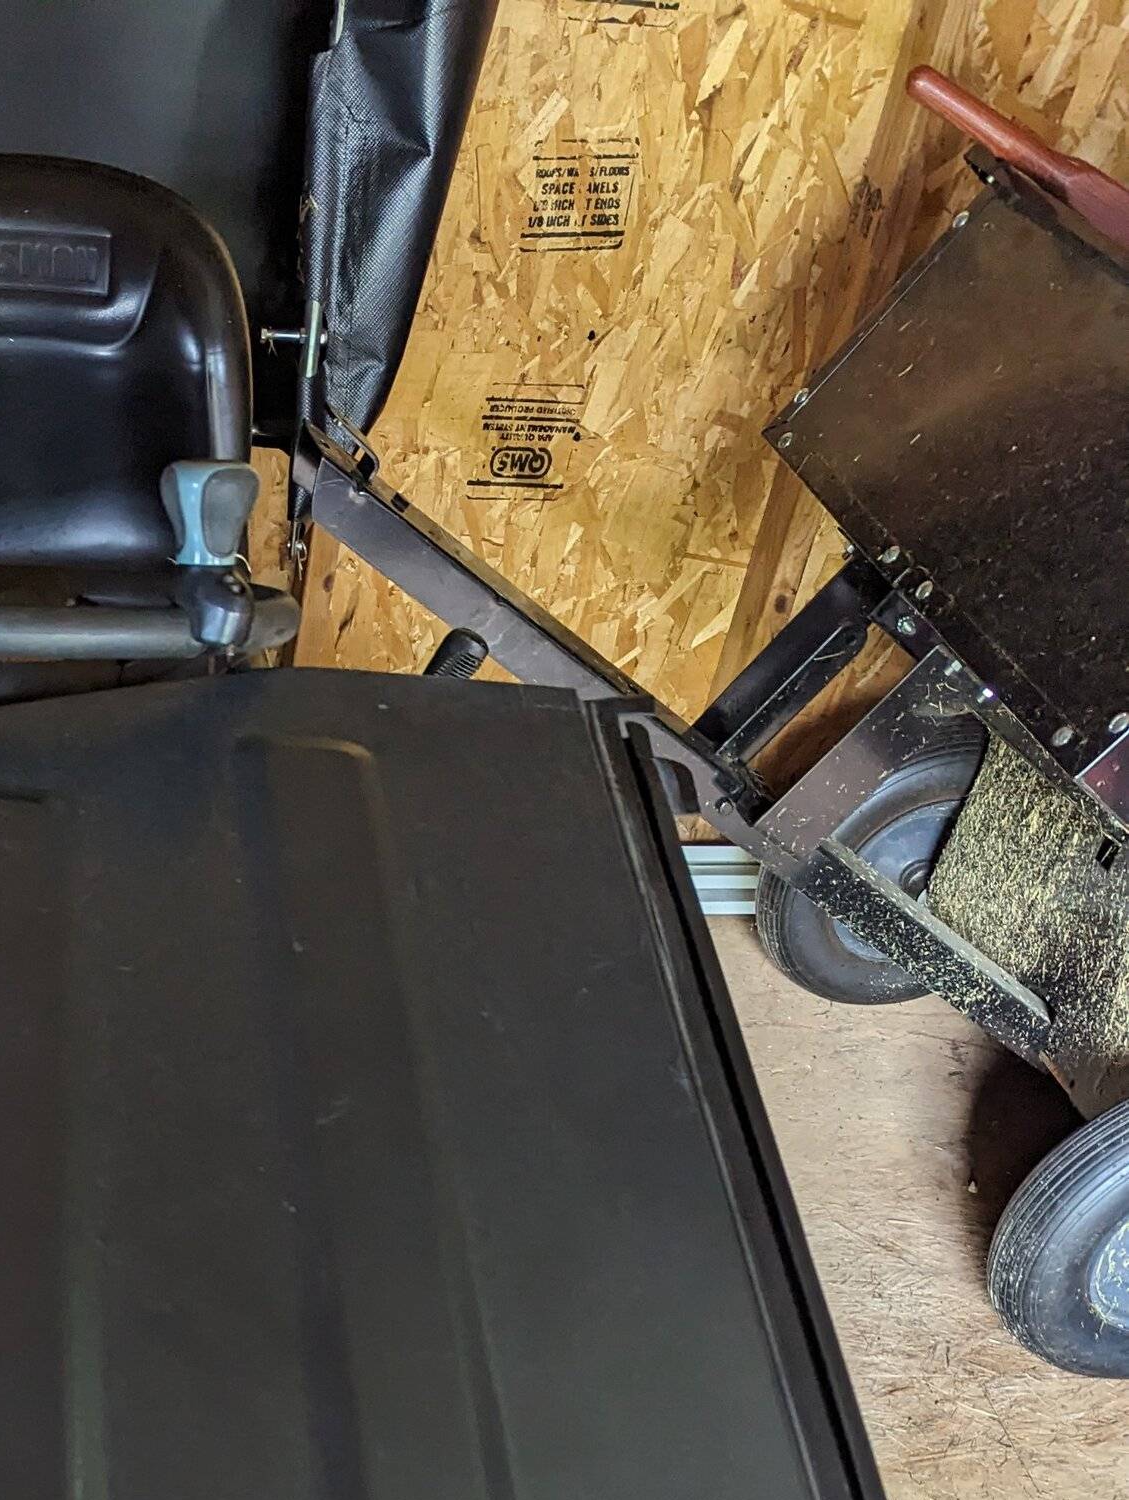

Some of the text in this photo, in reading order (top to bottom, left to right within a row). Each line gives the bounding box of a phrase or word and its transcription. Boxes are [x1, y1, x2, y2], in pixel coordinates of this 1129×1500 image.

[535, 166, 630, 178] ROOFS/WAS/FLOORS
[541, 181, 620, 195] SPACE ANELS
[594, 197, 621, 210] ENDS
[527, 216, 544, 228] 1/8
[546, 215, 571, 227] INCH
[589, 213, 619, 226] SIDES
[496, 451, 546, 473] QMS
